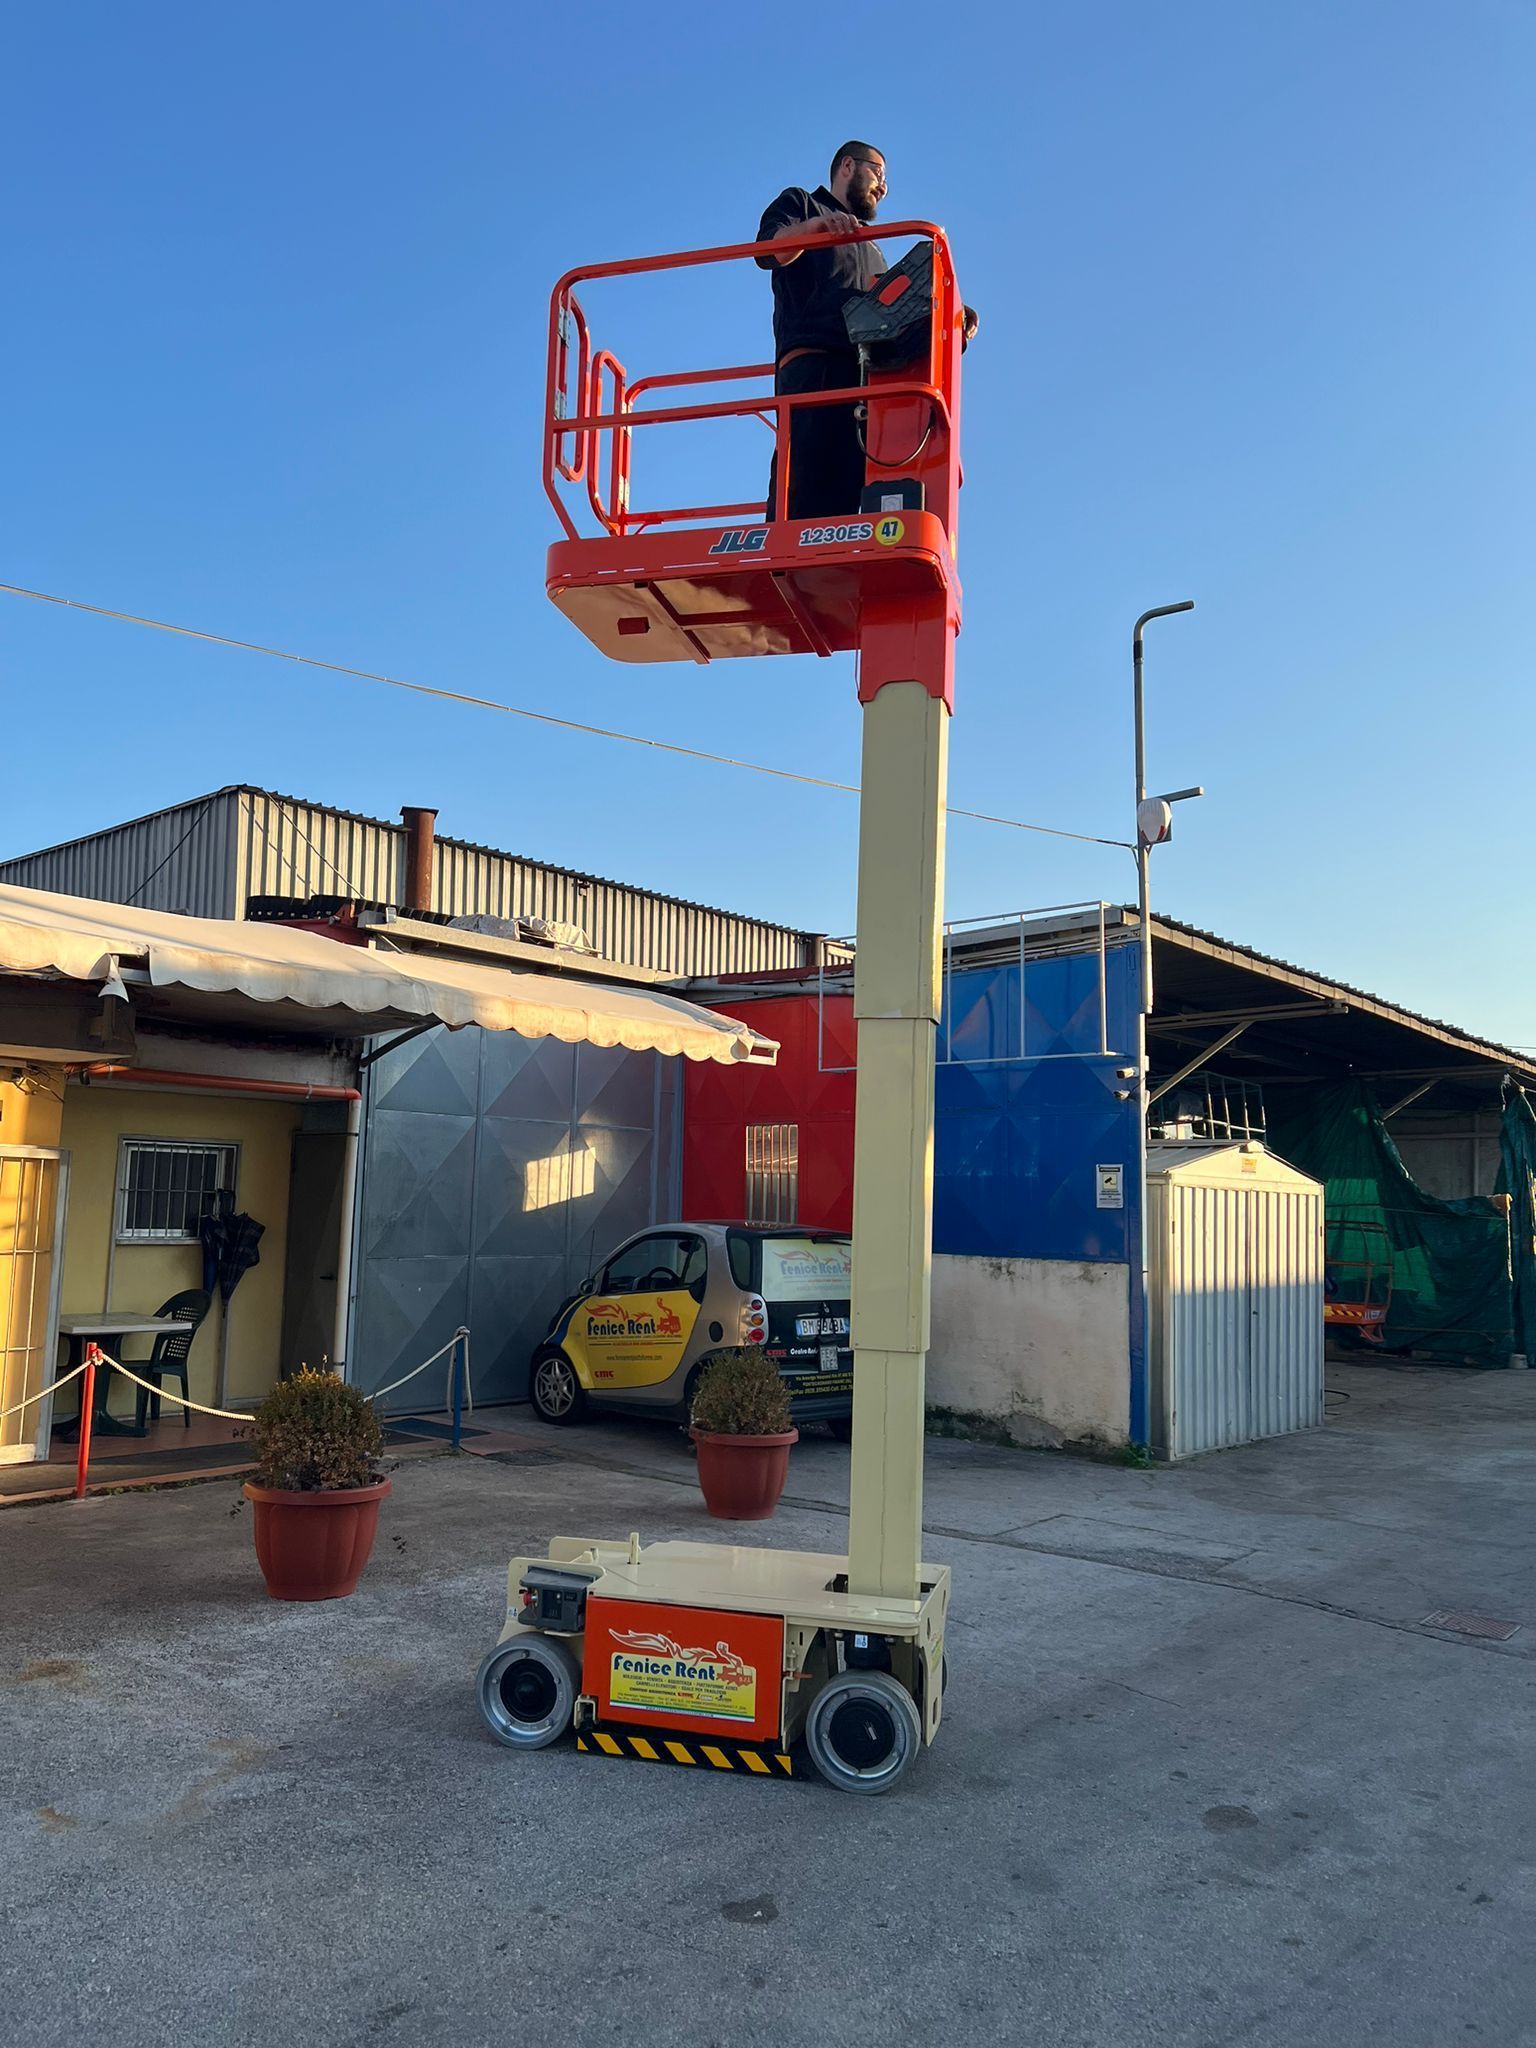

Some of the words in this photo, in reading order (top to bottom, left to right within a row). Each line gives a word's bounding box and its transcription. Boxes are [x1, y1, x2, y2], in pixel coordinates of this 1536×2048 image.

[799, 523, 873, 546] 1230ES
[881, 521, 898, 537] 47
[709, 528, 769, 554] JLG
[780, 1260, 817, 1275] Fenice
[819, 1262, 843, 1274] Rent
[588, 1317, 625, 1335] Fenice
[628, 1319, 656, 1334] Rent
[614, 1655, 671, 1675] Fenice
[676, 1662, 715, 1680] Rent
